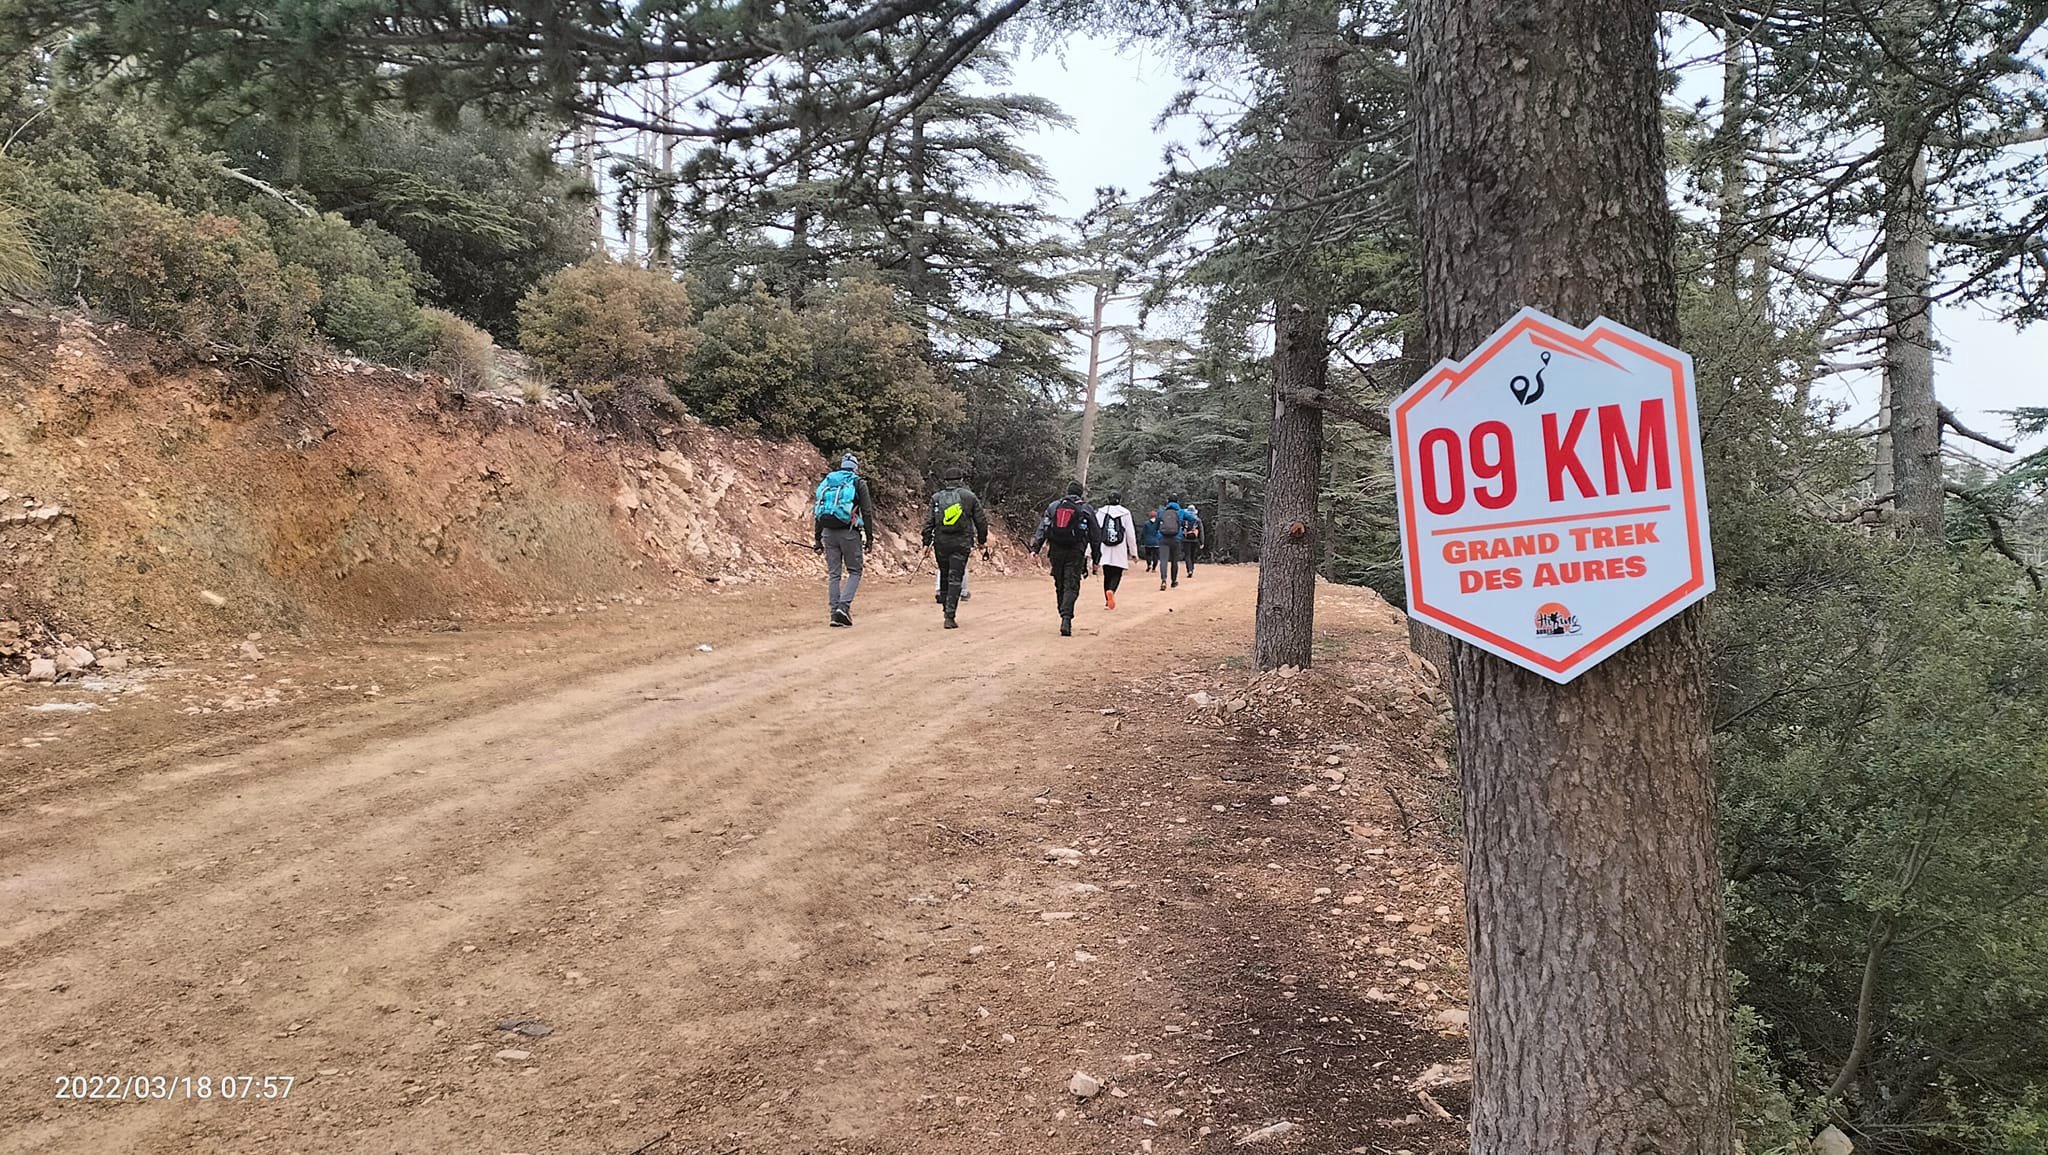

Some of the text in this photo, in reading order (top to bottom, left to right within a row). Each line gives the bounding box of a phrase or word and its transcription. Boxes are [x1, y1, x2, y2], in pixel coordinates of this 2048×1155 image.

[1419, 398, 1672, 515] 09 KM
[1442, 522, 1660, 564] GRAND TREK
[1459, 555, 1647, 594] DES AURES
